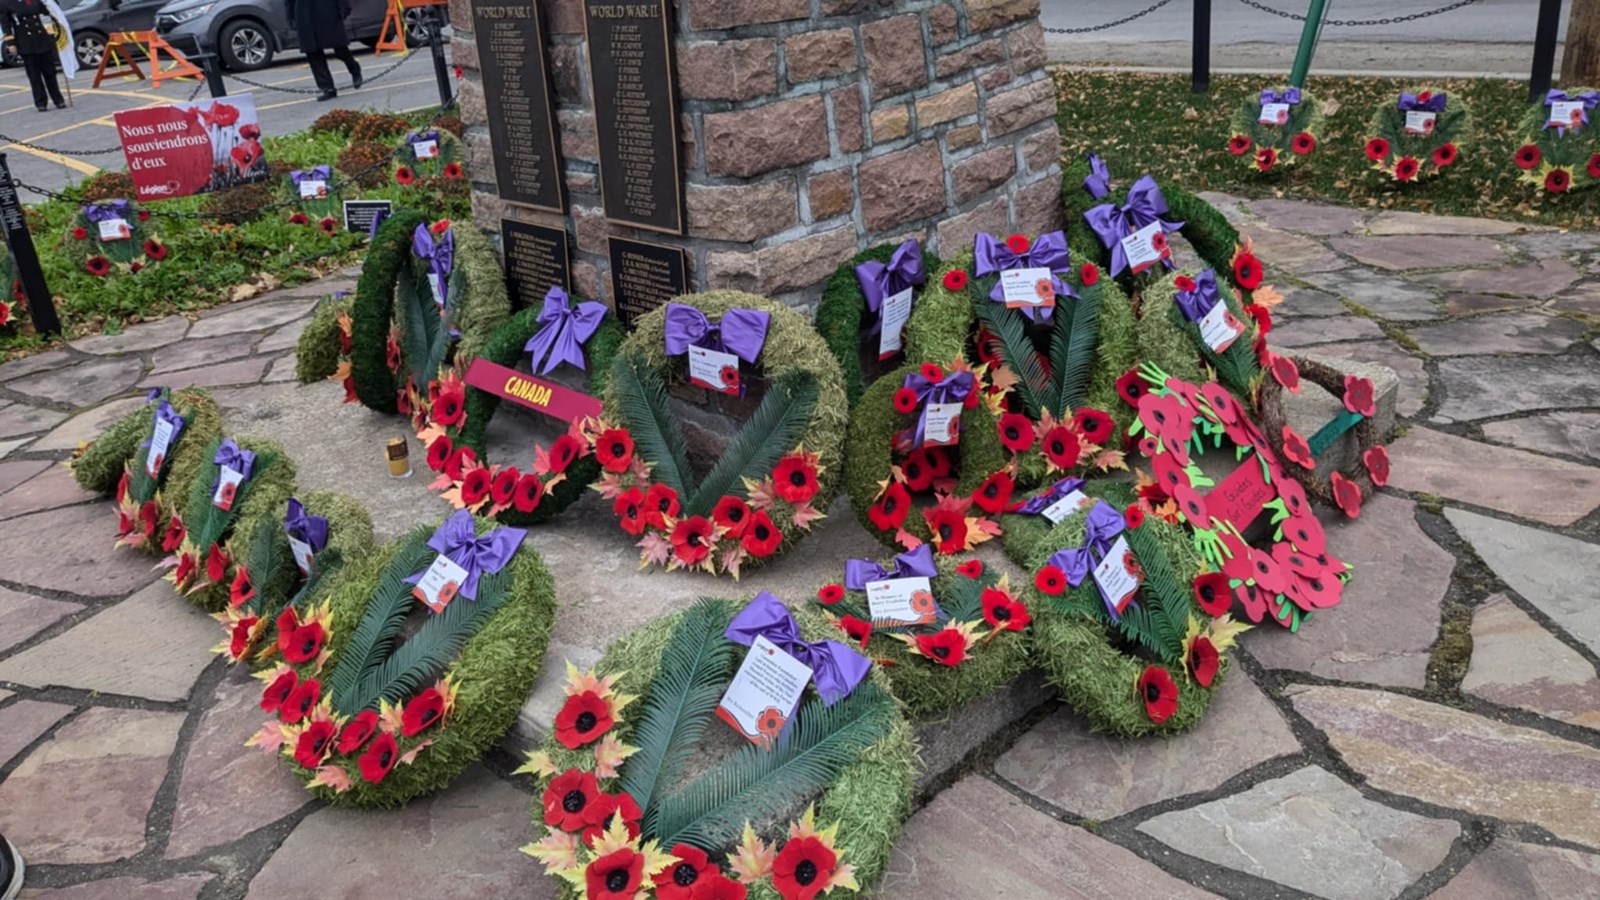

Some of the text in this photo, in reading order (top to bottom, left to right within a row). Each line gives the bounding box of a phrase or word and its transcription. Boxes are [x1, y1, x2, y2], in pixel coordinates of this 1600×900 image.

[476, 6, 505, 18] WORLD
[506, 6, 526, 18] WAR
[589, 5, 659, 18] WORLD WAR II
[121, 120, 188, 138] Nous nous
[127, 133, 209, 155] souviendrons
[132, 155, 167, 171] d'eux
[140, 182, 168, 196] Légion
[505, 377, 552, 406] CANADA
